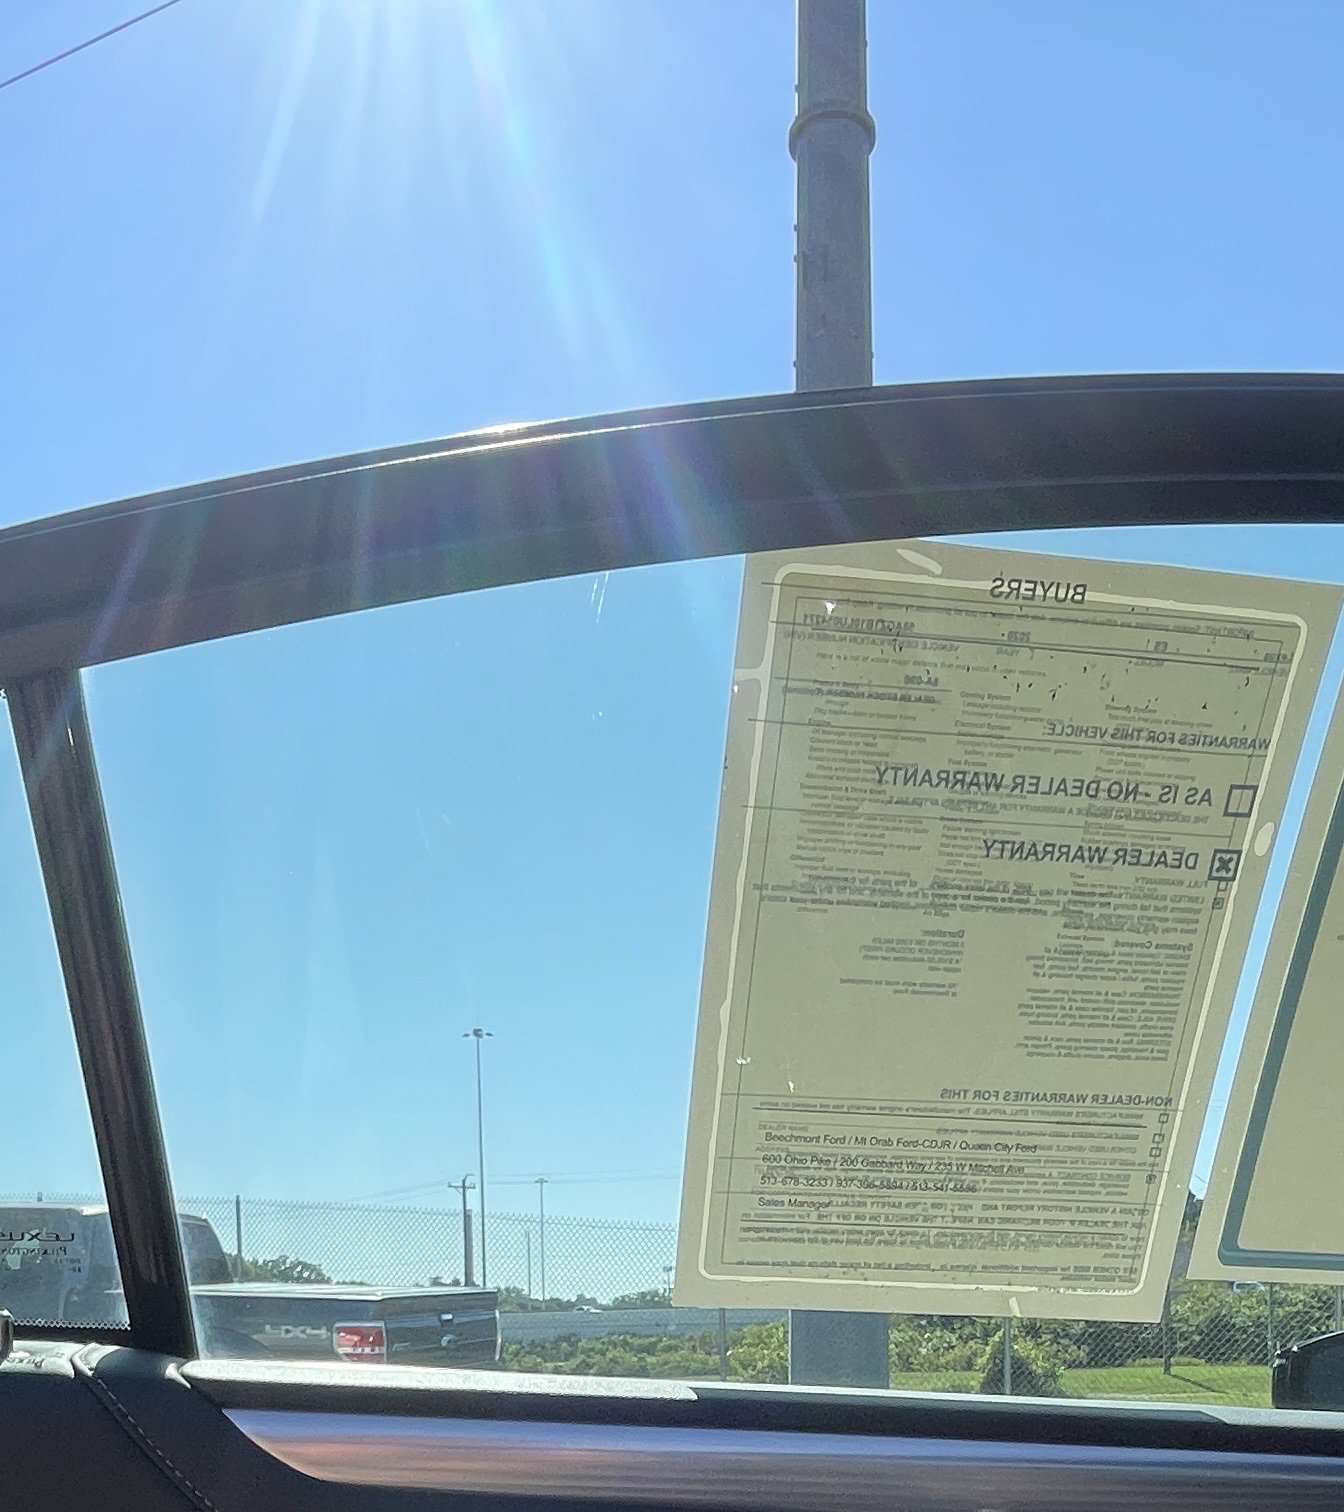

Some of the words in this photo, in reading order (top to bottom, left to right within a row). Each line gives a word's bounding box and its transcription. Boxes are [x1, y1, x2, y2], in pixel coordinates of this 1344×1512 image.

[765, 1132, 821, 1144] Beechmont
[823, 1134, 846, 1144] Ford
[870, 1136, 893, 1146] Orab
[896, 1138, 951, 1149] Ford-CDJR
[994, 1142, 1012, 1154] City
[1015, 1143, 1038, 1153] Ford
[762, 1154, 781, 1164] 600
[784, 1155, 808, 1164] Ohio
[840, 1158, 858, 1167] 200
[906, 1161, 926, 1172] Way
[758, 1197, 785, 1206] Sales
[789, 1199, 831, 1210] Manager
